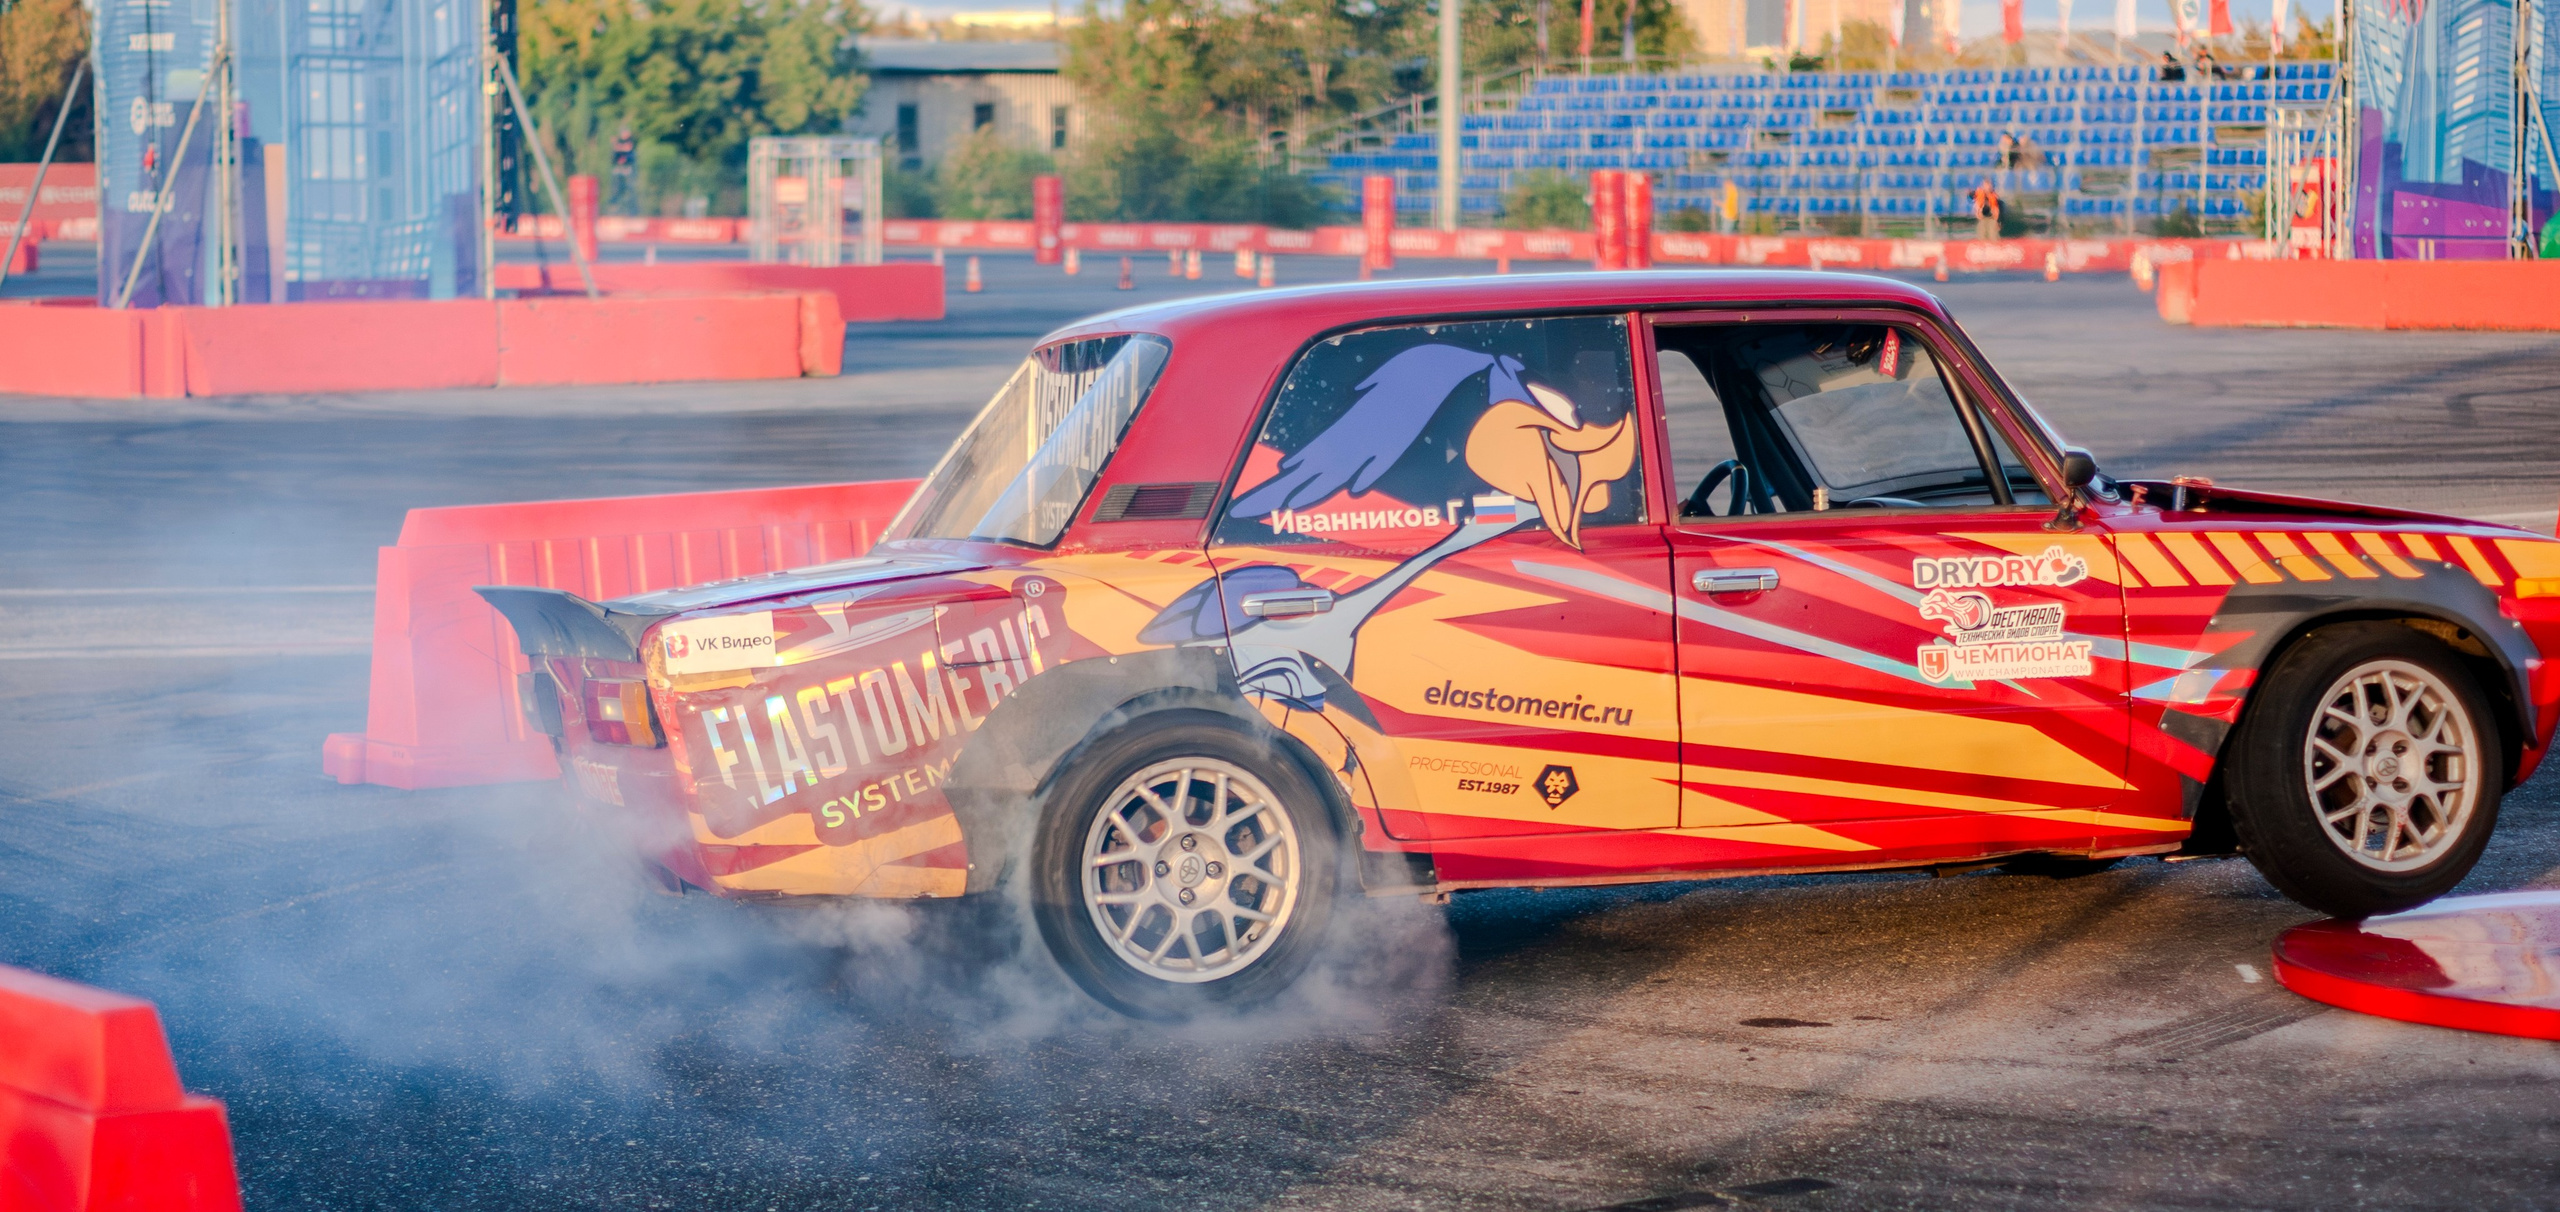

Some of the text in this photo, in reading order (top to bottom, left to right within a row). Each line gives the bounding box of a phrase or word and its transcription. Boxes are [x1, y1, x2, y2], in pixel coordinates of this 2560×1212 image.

[1270, 499, 1471, 535] Иванников Г.
[1916, 558, 2045, 585] DRYDRY
[1990, 605, 2061, 630] ФЕСТИВАЛЬ
[696, 634, 773, 651] VK Видео
[1959, 624, 2058, 643] ТЕХНИЧЕСКИХ ВИДОВ СПОРТА
[1954, 644, 2089, 665] ЧЕМПИОНАТ
[1955, 664, 2089, 679] WWW.CHAMPIONAT.COM
[1424, 679, 1634, 727] elastomeric.ru
[1409, 755, 1524, 780] PROFESSIONAL
[821, 748, 963, 829] SYSTEM
[1456, 778, 1521, 796] EST.1987
